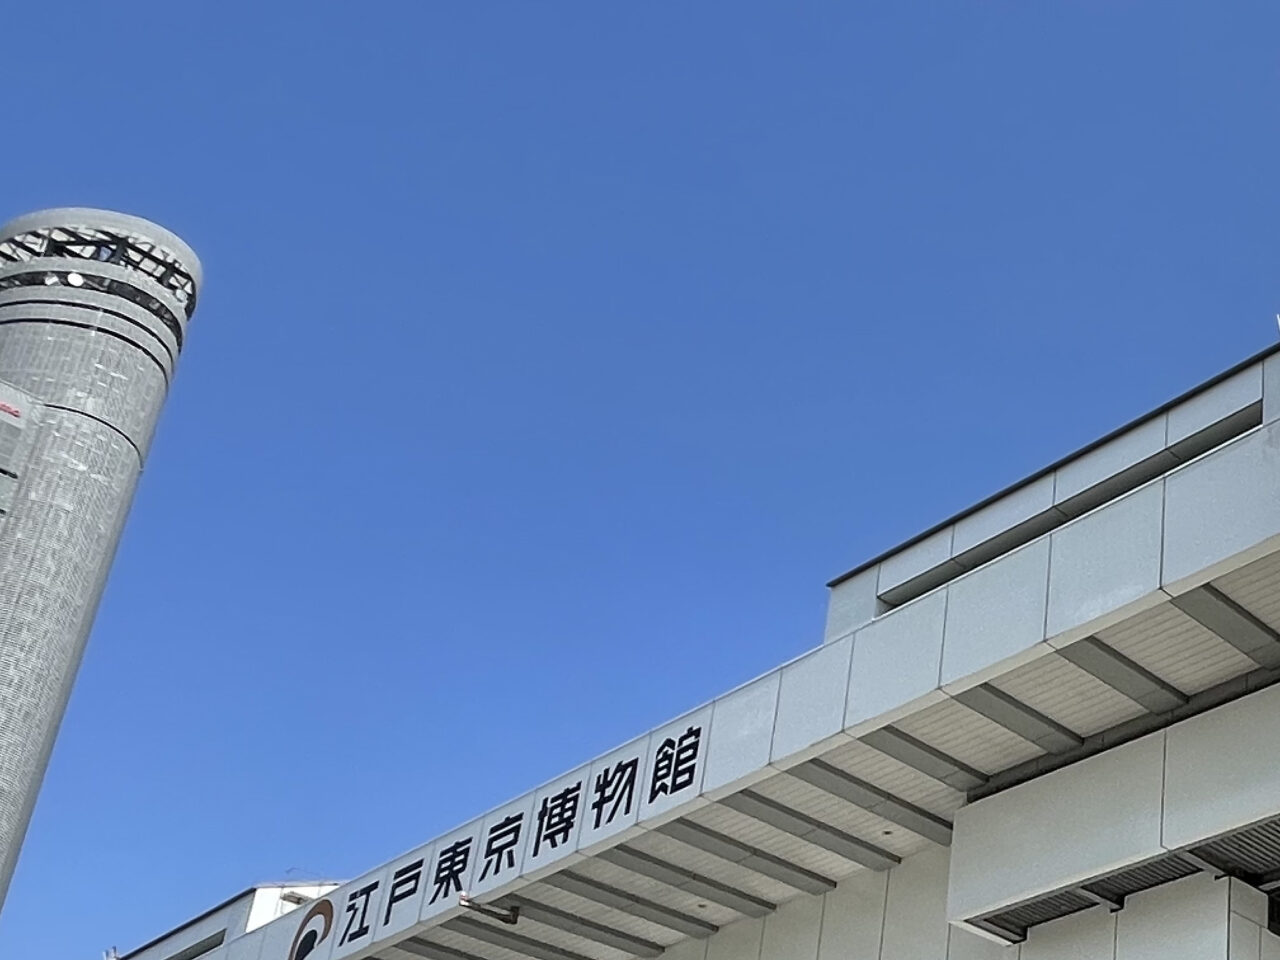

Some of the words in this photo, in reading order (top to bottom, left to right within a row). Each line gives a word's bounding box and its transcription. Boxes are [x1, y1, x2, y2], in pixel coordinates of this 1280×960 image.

[339, 726, 702, 947] 江戸東京博物館
